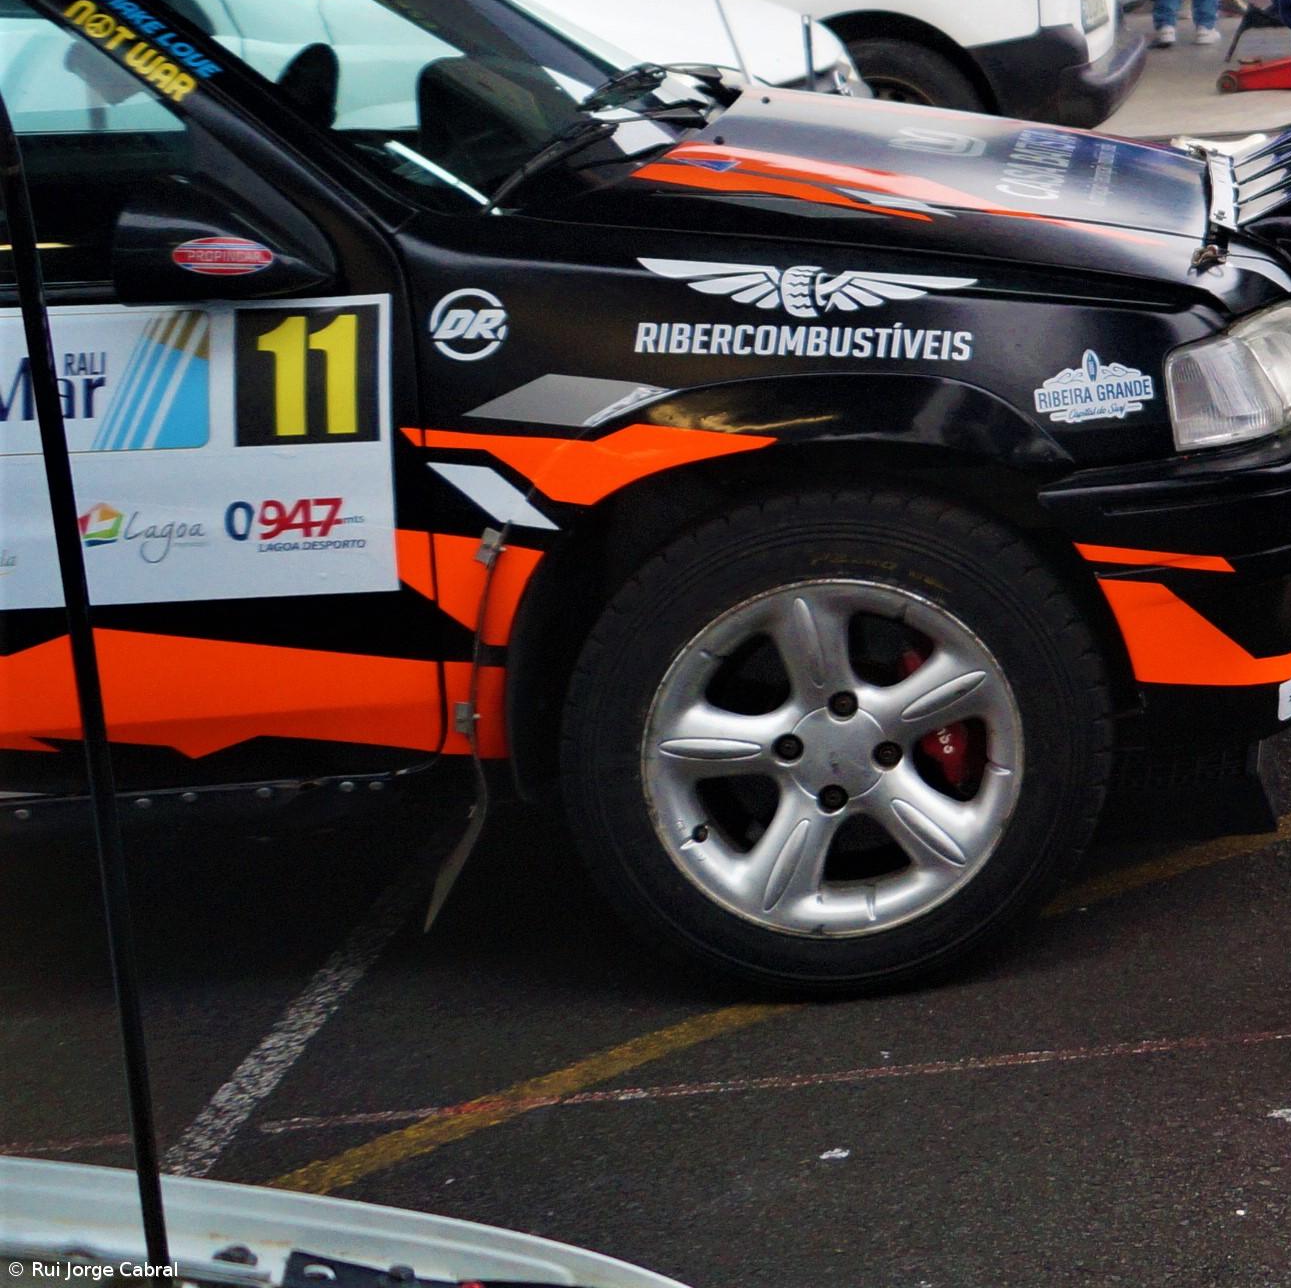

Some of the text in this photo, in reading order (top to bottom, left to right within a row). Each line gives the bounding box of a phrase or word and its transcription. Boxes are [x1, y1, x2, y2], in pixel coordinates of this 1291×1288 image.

[125, 41, 198, 102] WAR
[634, 321, 973, 362] RIBERCOMBUSTÍVEIS
[64, 351, 106, 376] RALI
[257, 314, 358, 436] 11
[1037, 378, 1152, 409] RIBEIRA GRANDE
[123, 510, 206, 563] Lagoa
[258, 539, 367, 553] LAGOA DESPORTO
